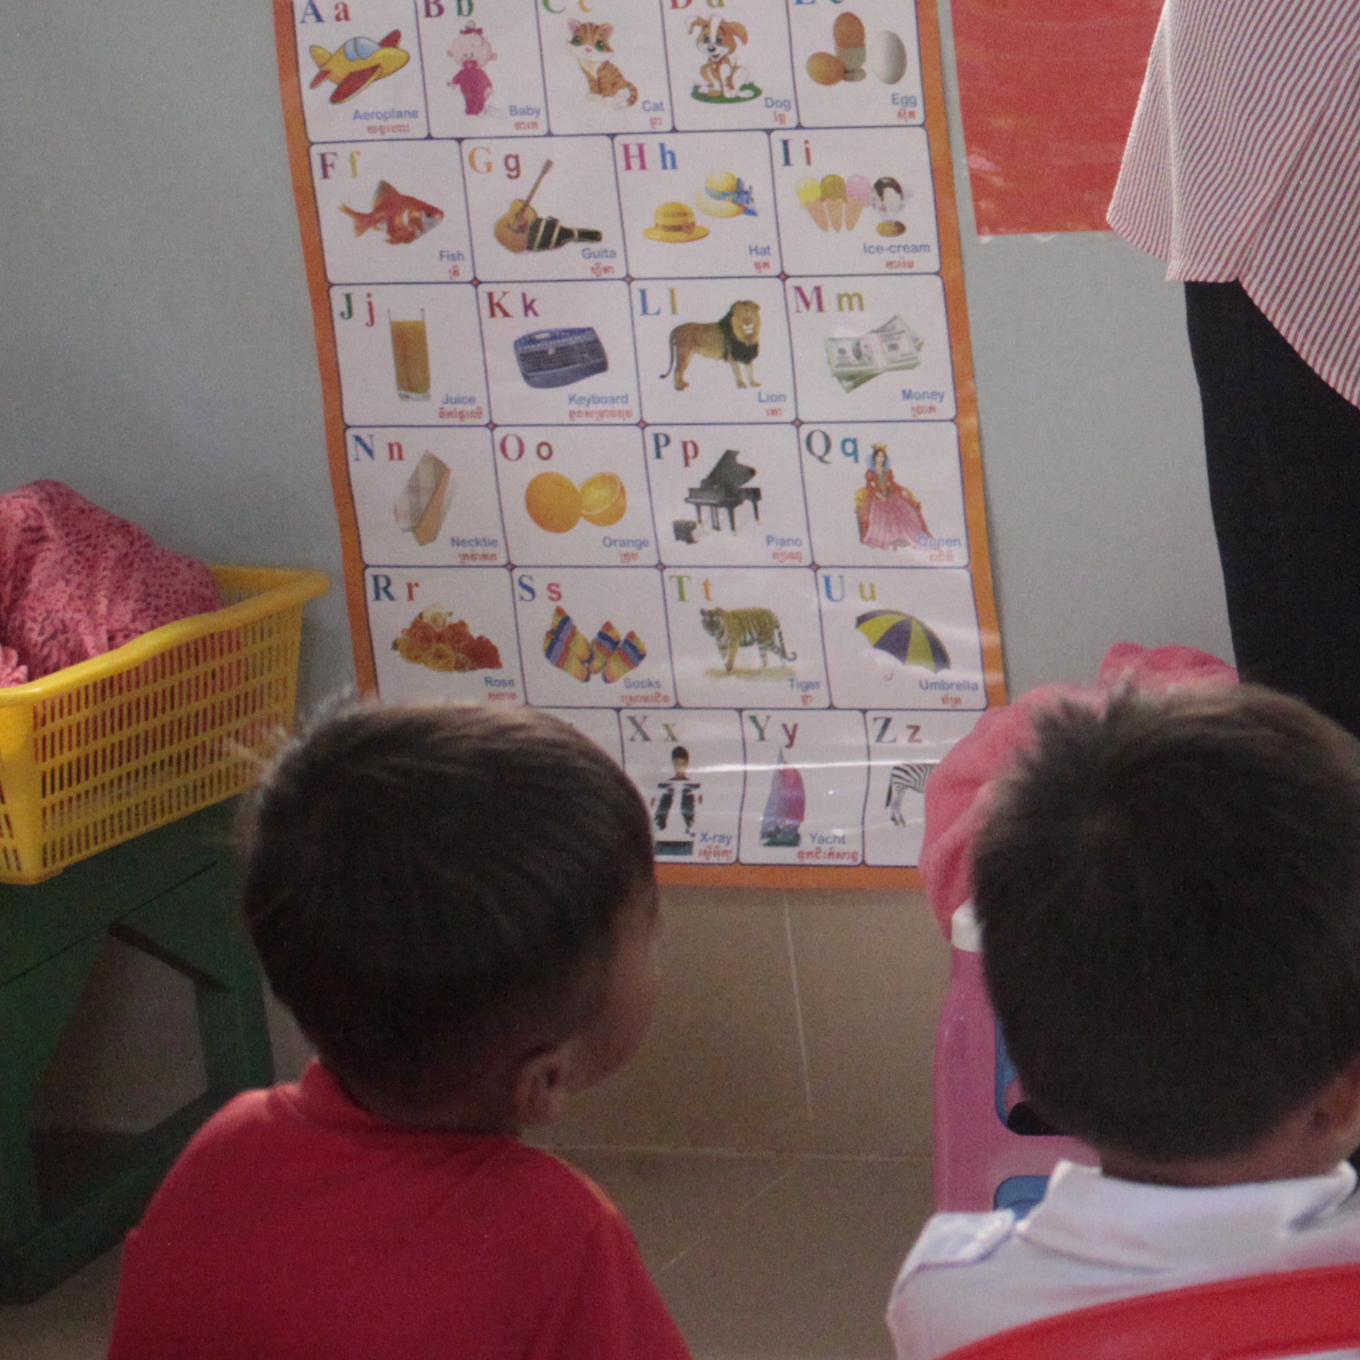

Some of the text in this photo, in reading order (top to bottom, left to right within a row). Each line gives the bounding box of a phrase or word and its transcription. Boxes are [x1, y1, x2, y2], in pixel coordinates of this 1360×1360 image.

[334, 0, 352, 21] a
[642, 101, 665, 112] Cat
[765, 97, 791, 110] Dog
[891, 94, 917, 107] Egg
[353, 108, 418, 121] Aeroplane
[509, 105, 541, 118] Baby
[621, 143, 678, 171] H h
[780, 140, 812, 167] I i
[318, 151, 361, 179] F f
[468, 147, 522, 179] G g
[439, 250, 465, 261] Fish
[581, 248, 617, 259] Guita
[749, 245, 772, 256] Hat
[863, 243, 931, 254] Ice-cream
[486, 291, 541, 318] K k
[638, 288, 679, 316] L l
[794, 286, 864, 313] M m
[339, 293, 375, 327] J j
[442, 393, 476, 405] Juice
[568, 393, 629, 405] Keyboard
[758, 392, 787, 403] Lion
[902, 389, 945, 403] Money
[352, 434, 404, 461] N n
[500, 433, 553, 461] O o
[652, 432, 700, 467] P p
[805, 429, 859, 464] Q q
[451, 537, 498, 548] Necktie
[602, 537, 649, 549] Orange
[766, 536, 804, 547] Piano
[917, 536, 961, 548] Queen
[371, 574, 420, 601] R r
[518, 574, 562, 601] S s
[669, 575, 713, 602] T t
[822, 575, 877, 602] U u
[484, 677, 516, 688] Rose
[623, 677, 662, 689] Socks
[789, 679, 820, 691] Tiger
[918, 679, 979, 691] Umbrella
[626, 715, 678, 742] X x
[749, 715, 799, 748] Y y
[873, 717, 922, 743] Z z
[700, 832, 733, 847] X-ray
[810, 832, 847, 845] Yacht
